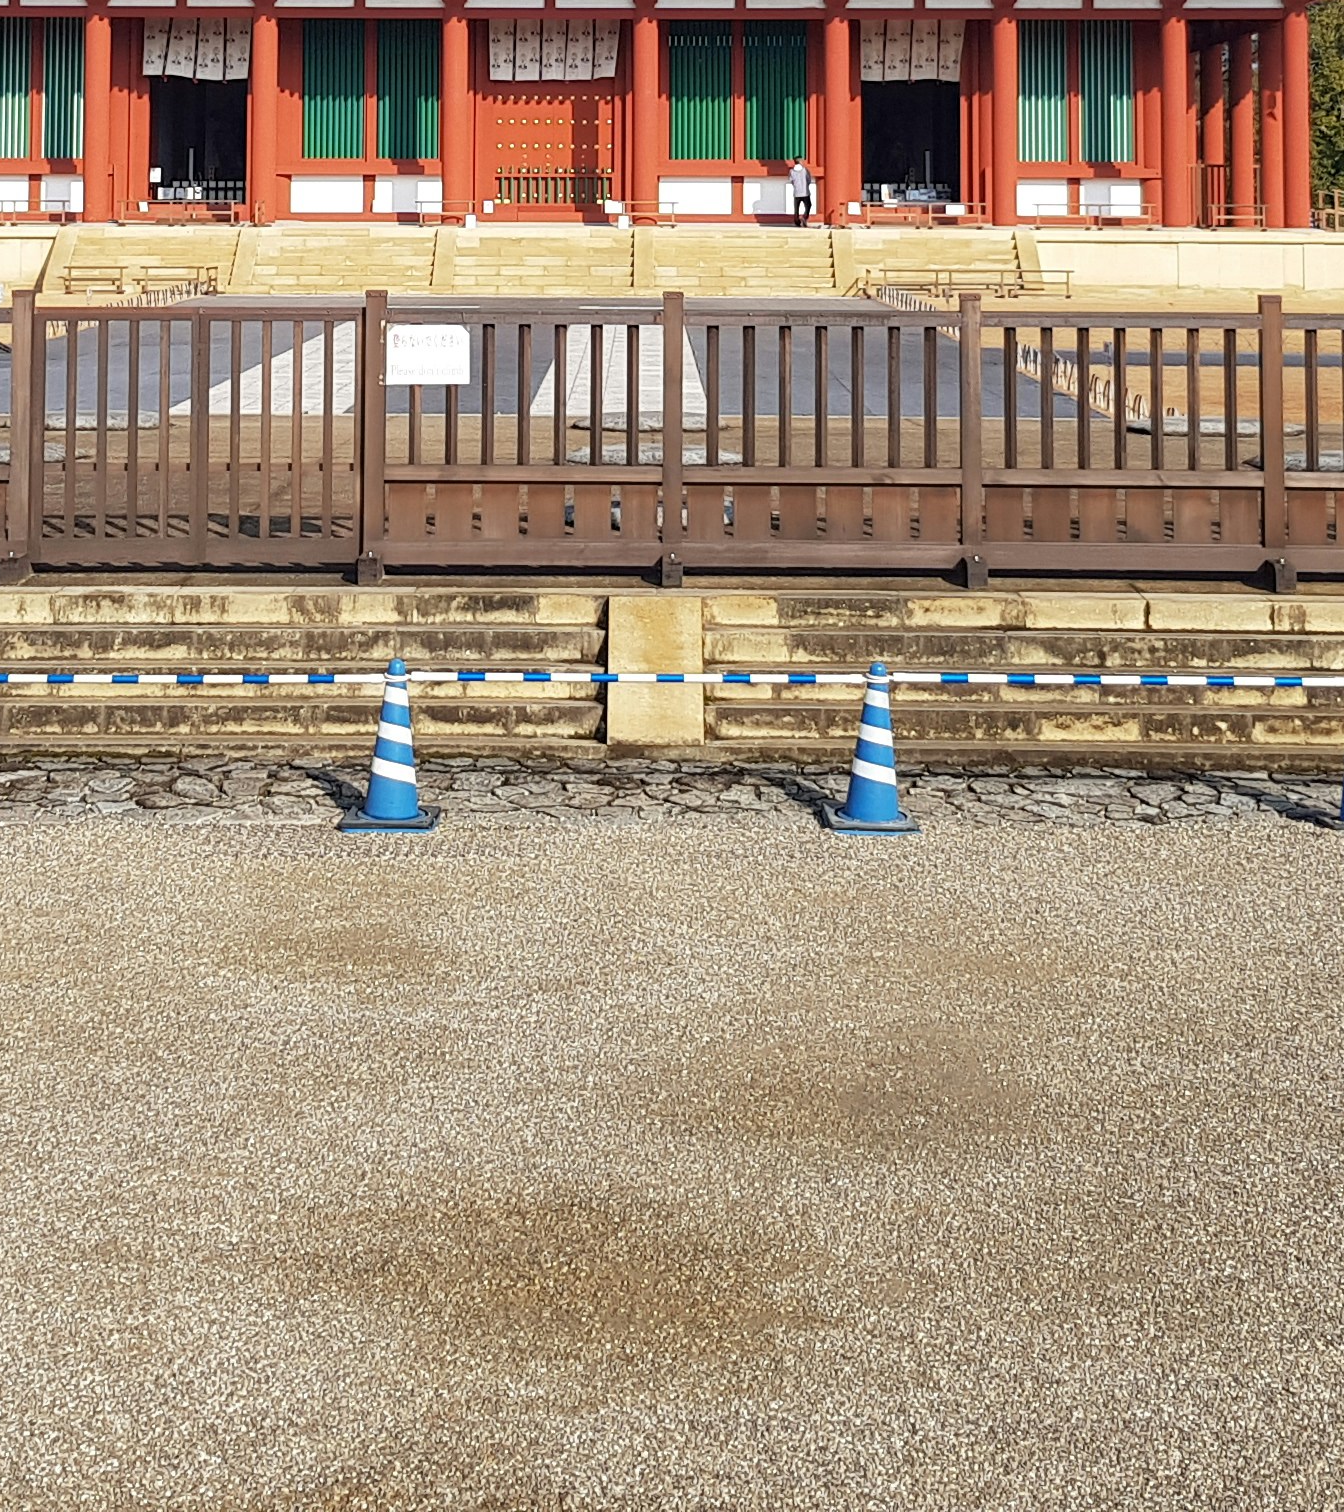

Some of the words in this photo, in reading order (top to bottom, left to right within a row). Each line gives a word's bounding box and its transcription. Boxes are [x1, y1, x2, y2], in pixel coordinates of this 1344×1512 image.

[392, 333, 463, 348] 登らないでください
[391, 364, 415, 376] Please
